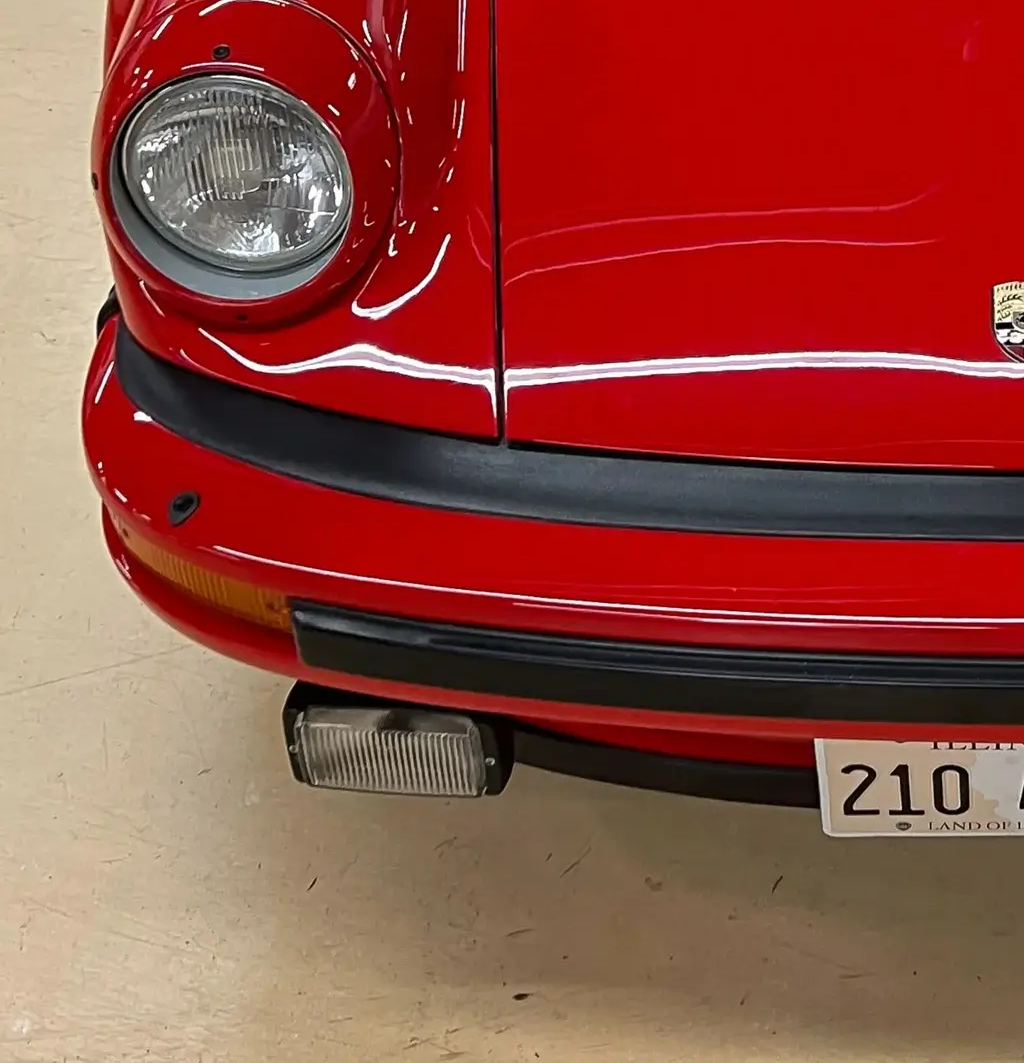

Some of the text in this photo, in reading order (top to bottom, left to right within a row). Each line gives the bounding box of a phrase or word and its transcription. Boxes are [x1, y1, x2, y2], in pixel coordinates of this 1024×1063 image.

[841, 764, 970, 816] 210
[928, 821, 981, 831] LAND
[986, 821, 1011, 830] OF
